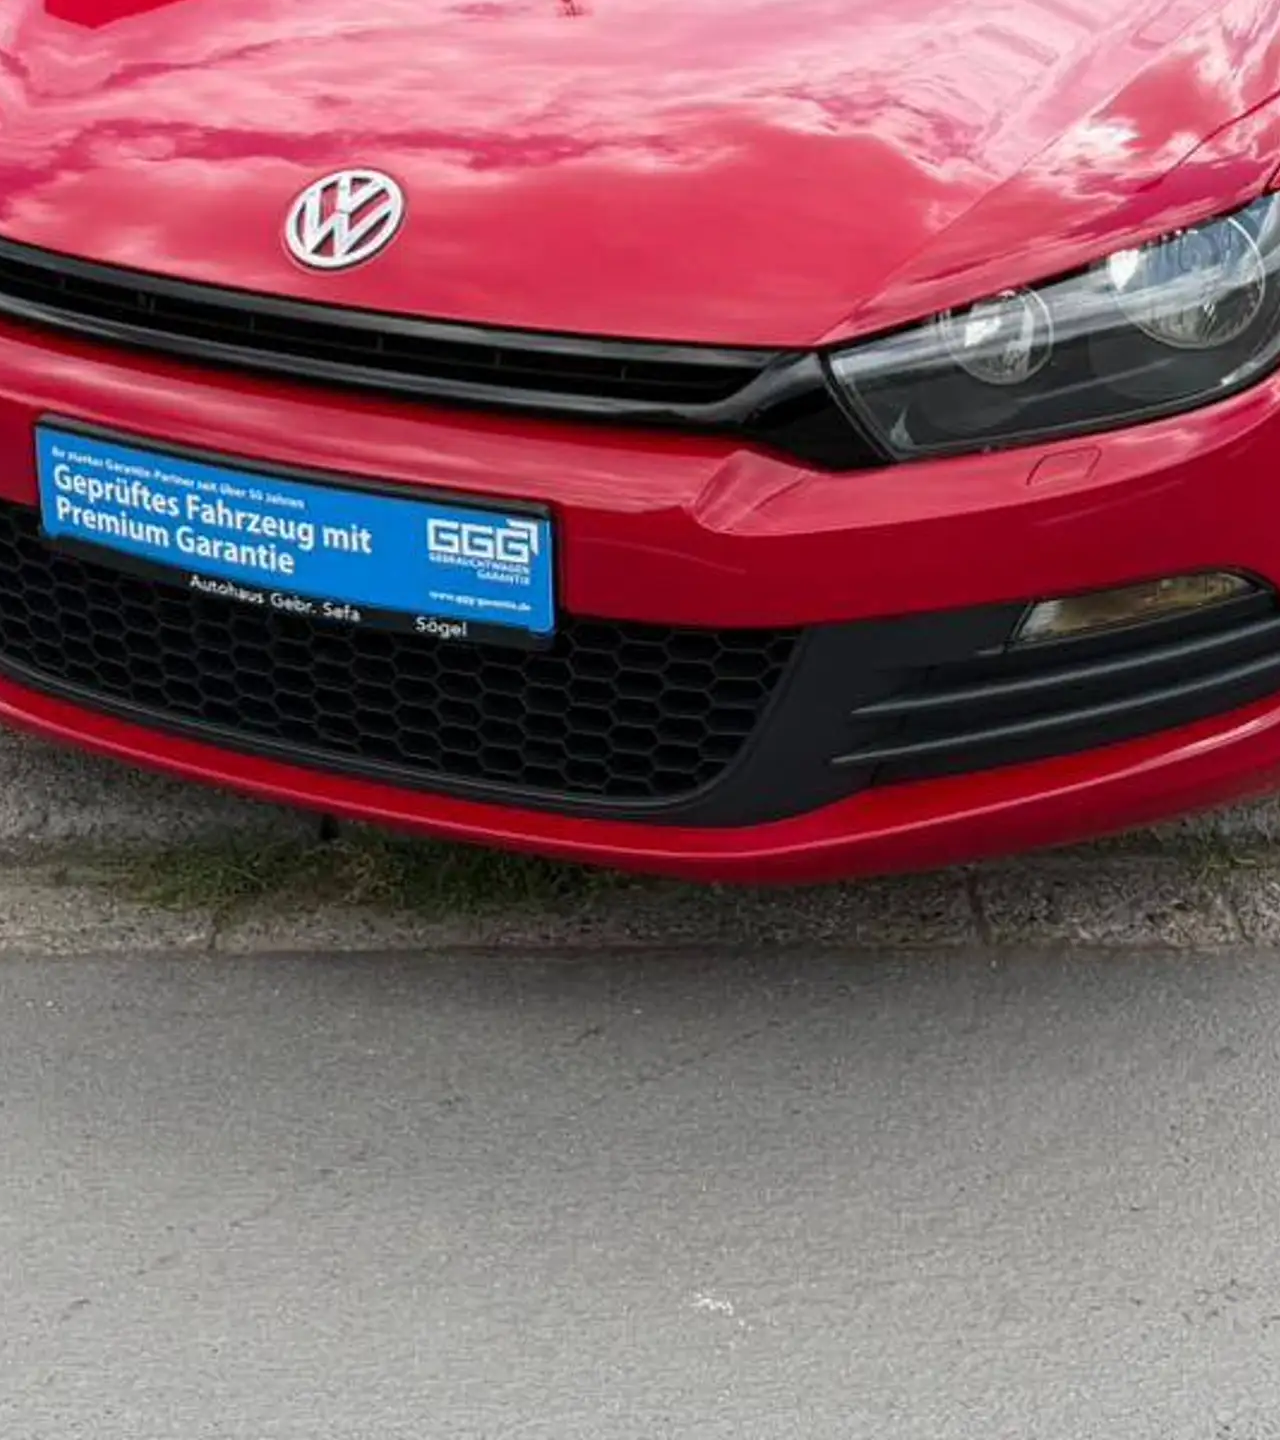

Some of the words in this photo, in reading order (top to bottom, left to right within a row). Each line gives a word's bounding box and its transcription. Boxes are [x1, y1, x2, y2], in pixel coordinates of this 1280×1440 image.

[284, 169, 405, 270] VW
[53, 463, 180, 517] Geprüftes
[185, 492, 315, 551] Fahrzeug
[322, 523, 372, 555] mit
[55, 494, 170, 548] Premium
[175, 524, 295, 575] Garantie
[189, 574, 265, 605] Autohaus
[270, 592, 318, 615] Gebr.
[415, 616, 468, 639] Sögel
